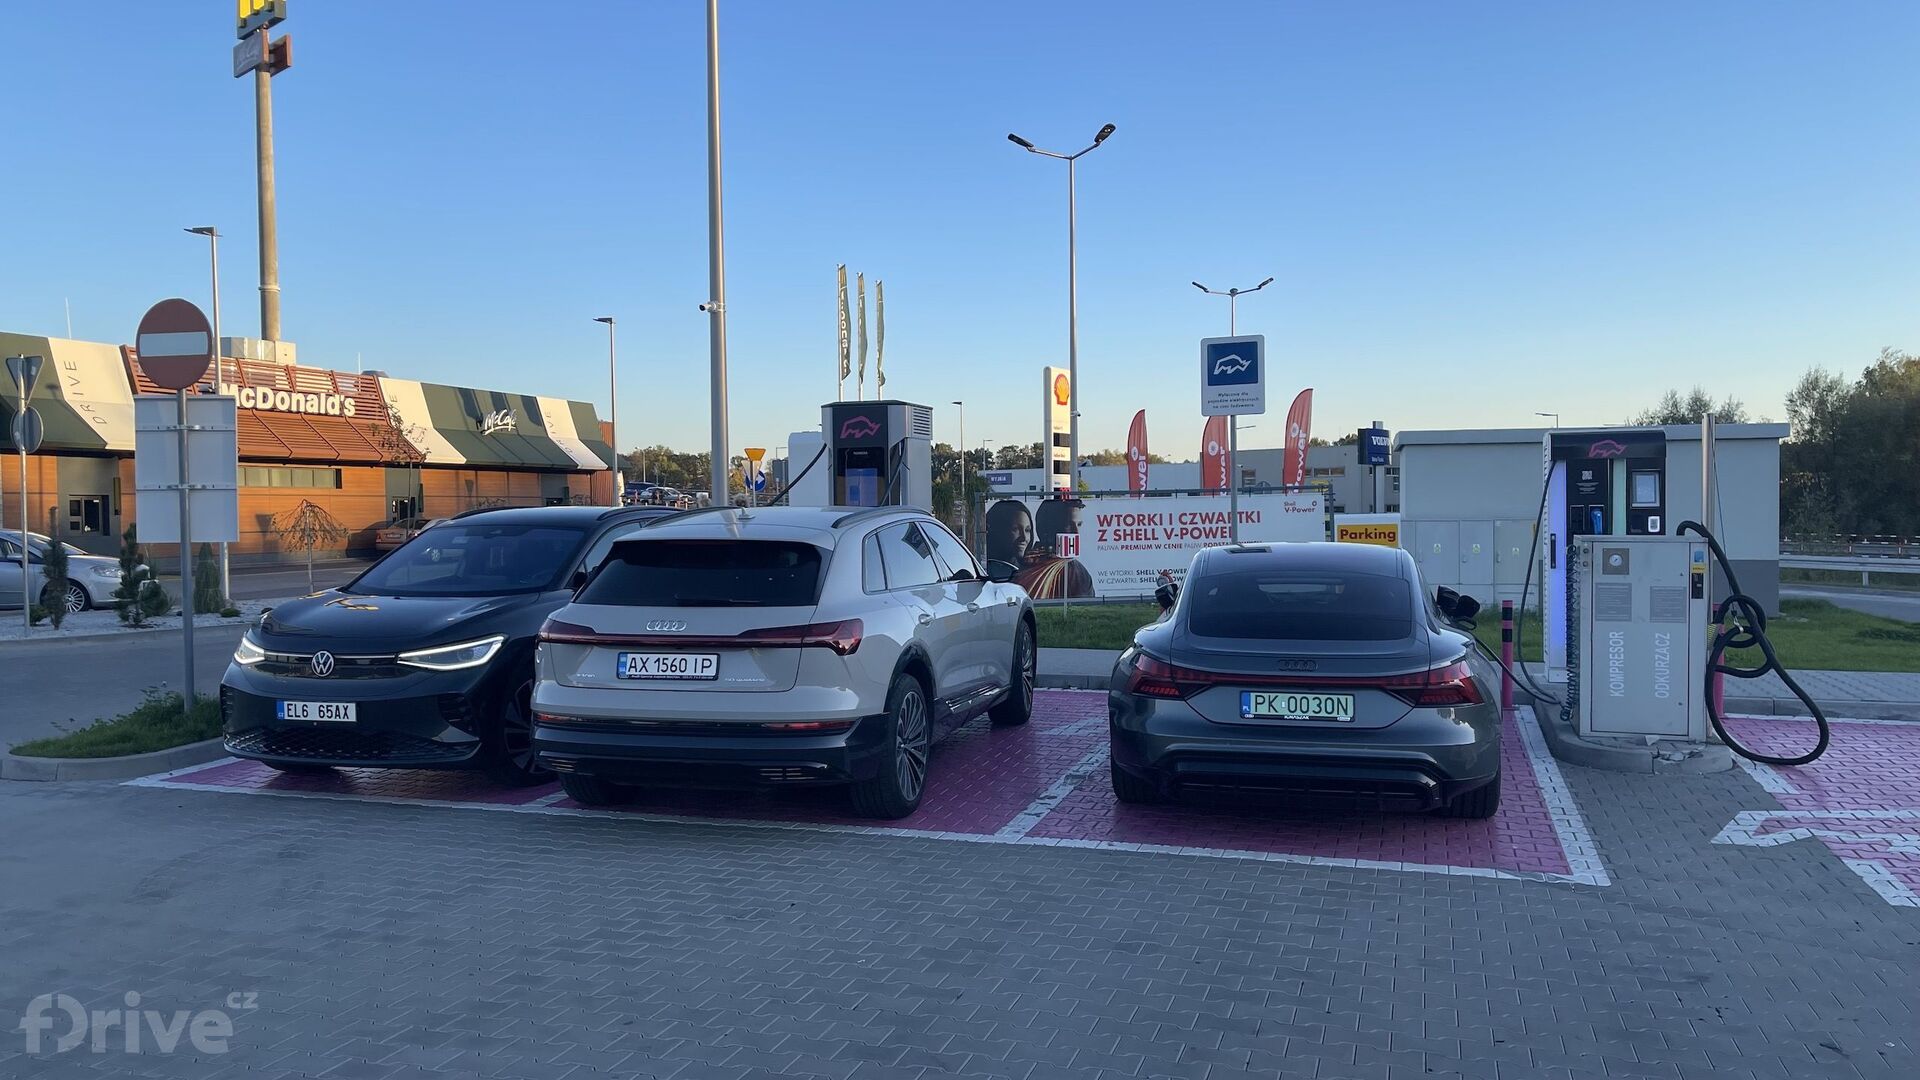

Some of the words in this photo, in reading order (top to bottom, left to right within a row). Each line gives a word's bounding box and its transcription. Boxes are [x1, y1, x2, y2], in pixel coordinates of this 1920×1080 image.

[64, 360, 108, 424] DRIVE
[1096, 512, 1164, 527] WTORKI
[1168, 511, 1173, 526] I
[1097, 529, 1108, 543] Z
[1113, 527, 1159, 542] SHELL
[1340, 527, 1396, 542] Parking
[628, 657, 649, 673] AX
[653, 657, 687, 673] 1560
[694, 658, 712, 674] IP
[1609, 631, 1624, 697] KOMPRESOR
[1655, 632, 1670, 698] ODKURZACZ
[287, 703, 309, 719] EL6
[318, 704, 349, 720] 65AX
[1254, 694, 1279, 713] PK
[1287, 696, 1348, 715] 0030N
